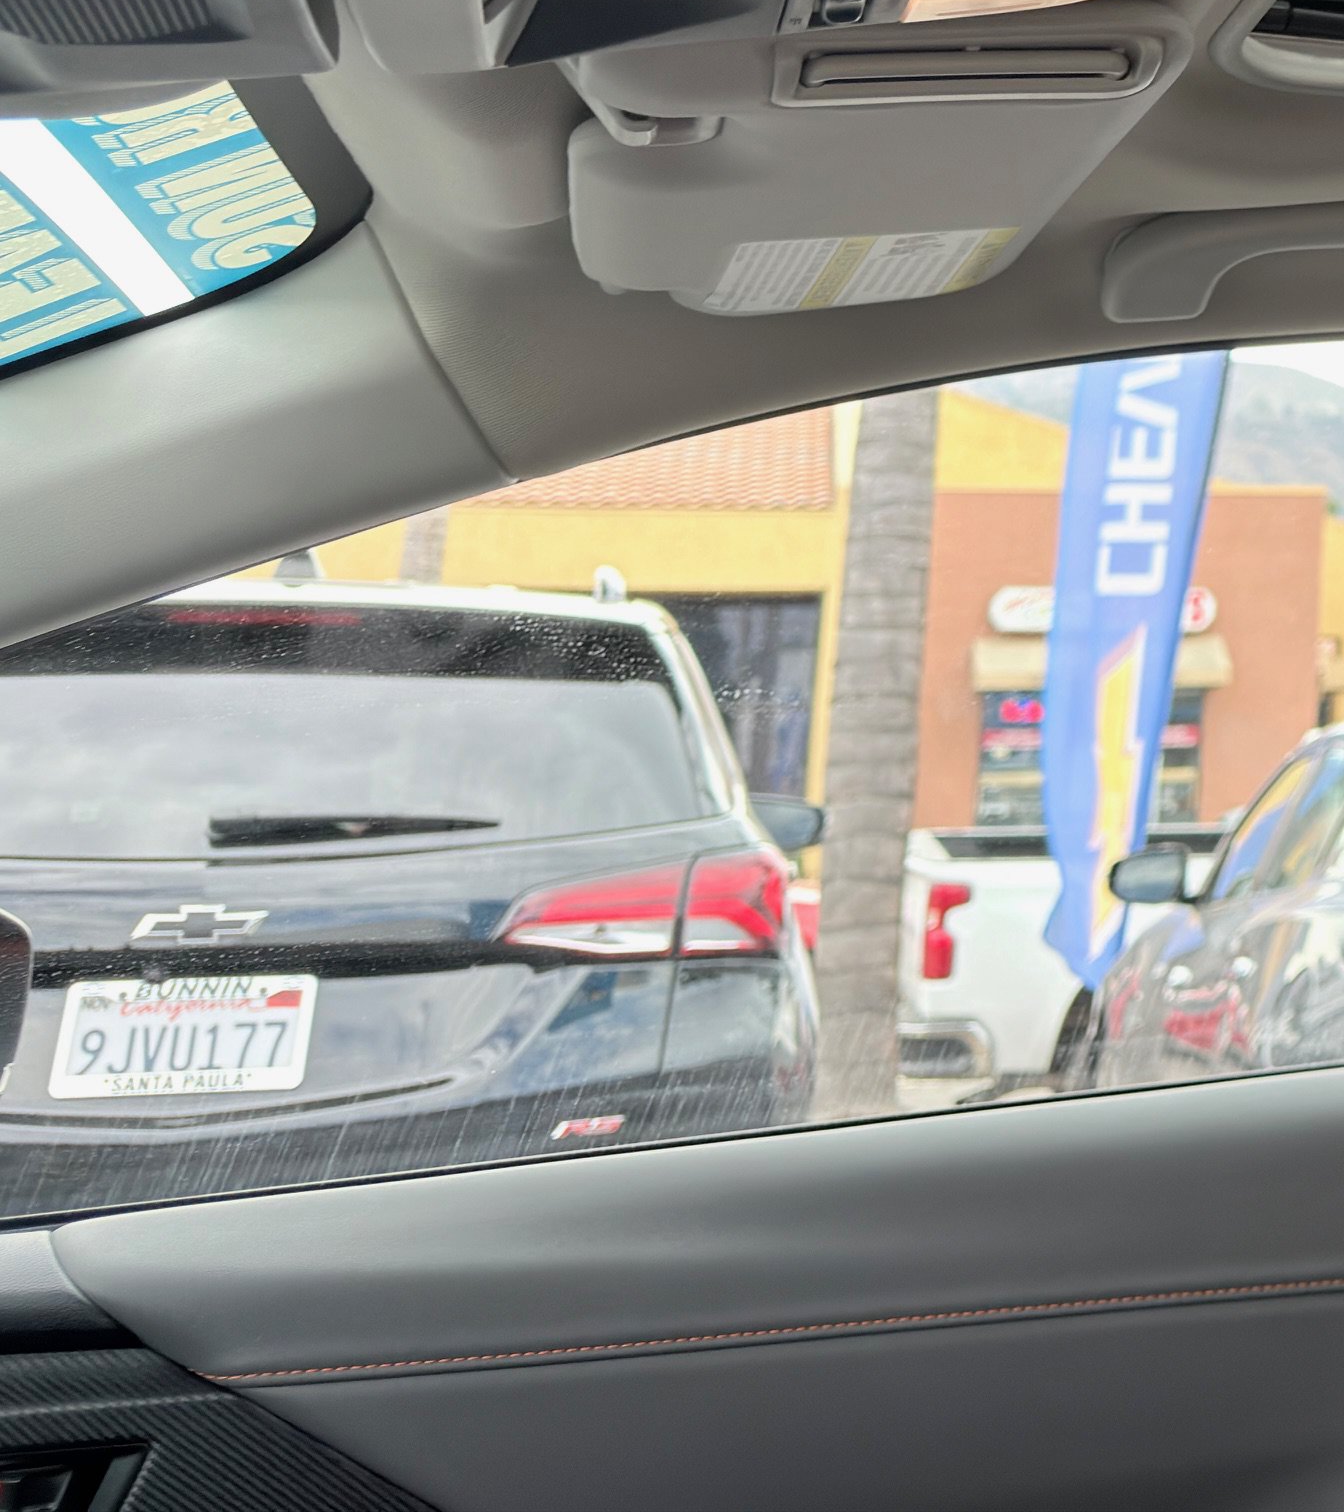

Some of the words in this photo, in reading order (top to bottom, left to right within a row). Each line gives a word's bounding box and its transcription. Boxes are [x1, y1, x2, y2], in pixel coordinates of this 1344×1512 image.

[76, 1021, 289, 1076] 9JVU177
[111, 1075, 173, 1092] SANTA
[183, 1073, 244, 1090] PAULA
